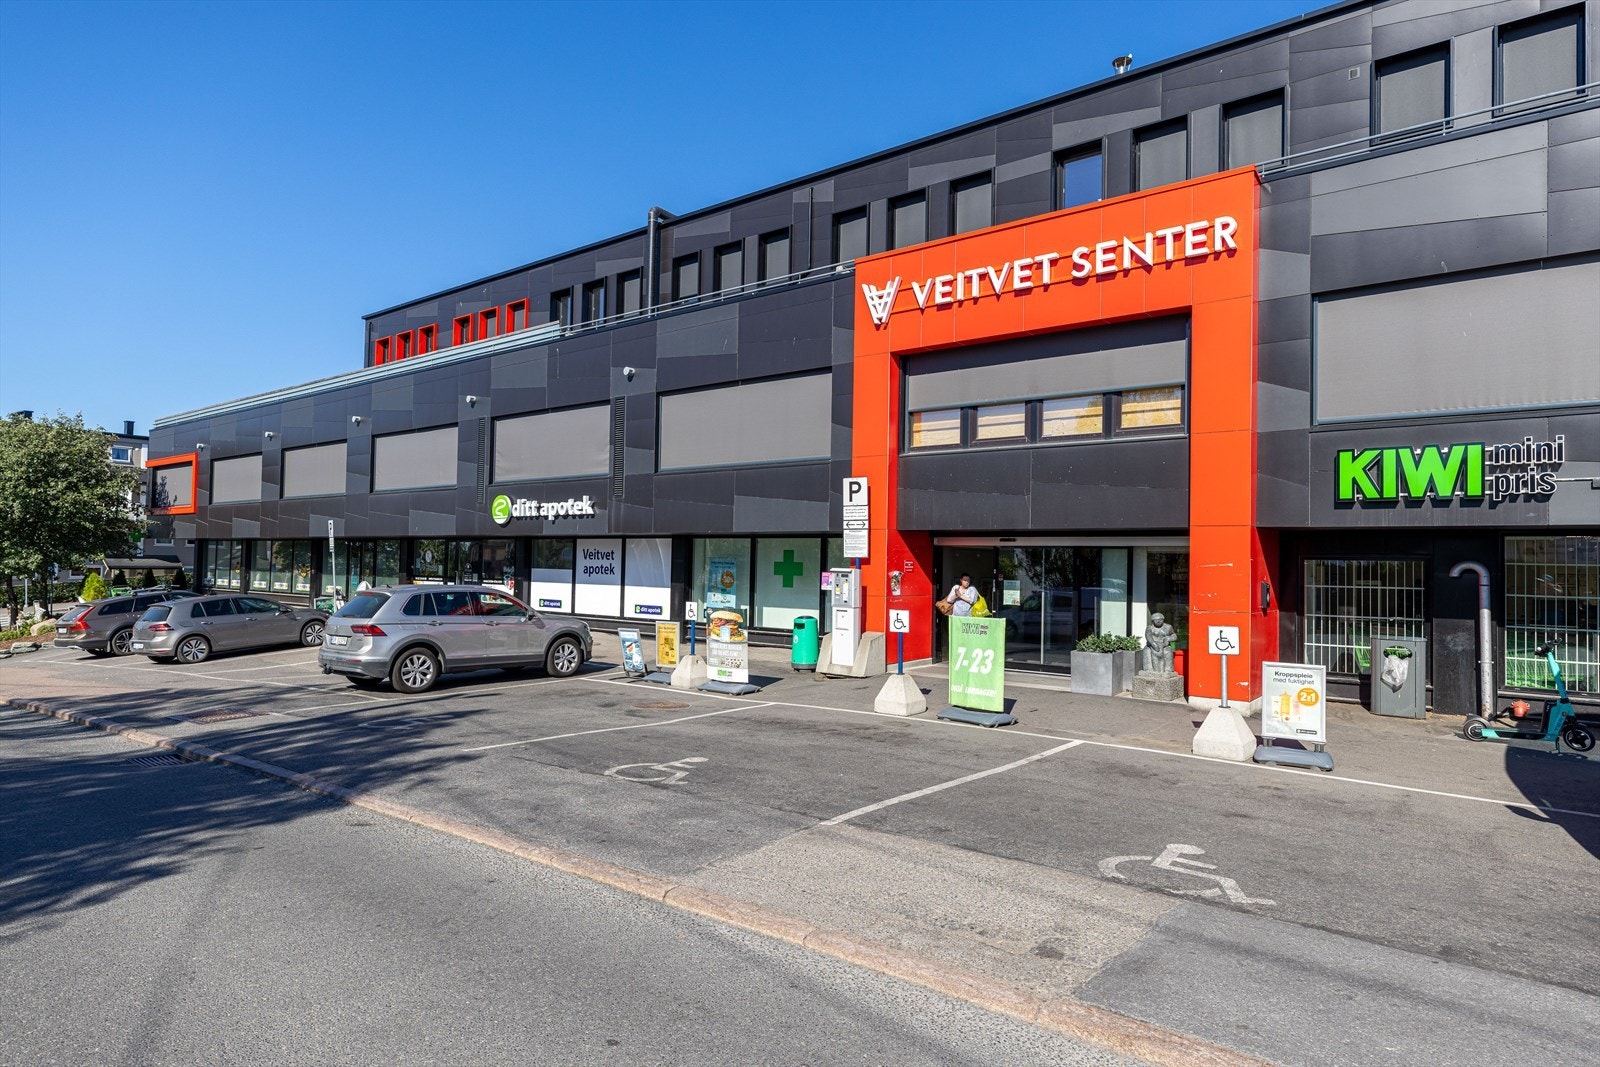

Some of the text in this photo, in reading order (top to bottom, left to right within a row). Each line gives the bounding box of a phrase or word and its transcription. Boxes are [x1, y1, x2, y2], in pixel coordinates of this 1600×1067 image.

[911, 215, 1239, 310] VEITVET SENTER
[1337, 434, 1565, 501] KIWI mini
[849, 481, 862, 502] P
[1492, 466, 1558, 501] pris
[512, 495, 595, 520] ditt apotek
[582, 548, 615, 560] Veitvet
[583, 562, 616, 577] apotek
[1274, 670, 1313, 679] Kroppspleie
[1288, 677, 1315, 685] fuktighet
